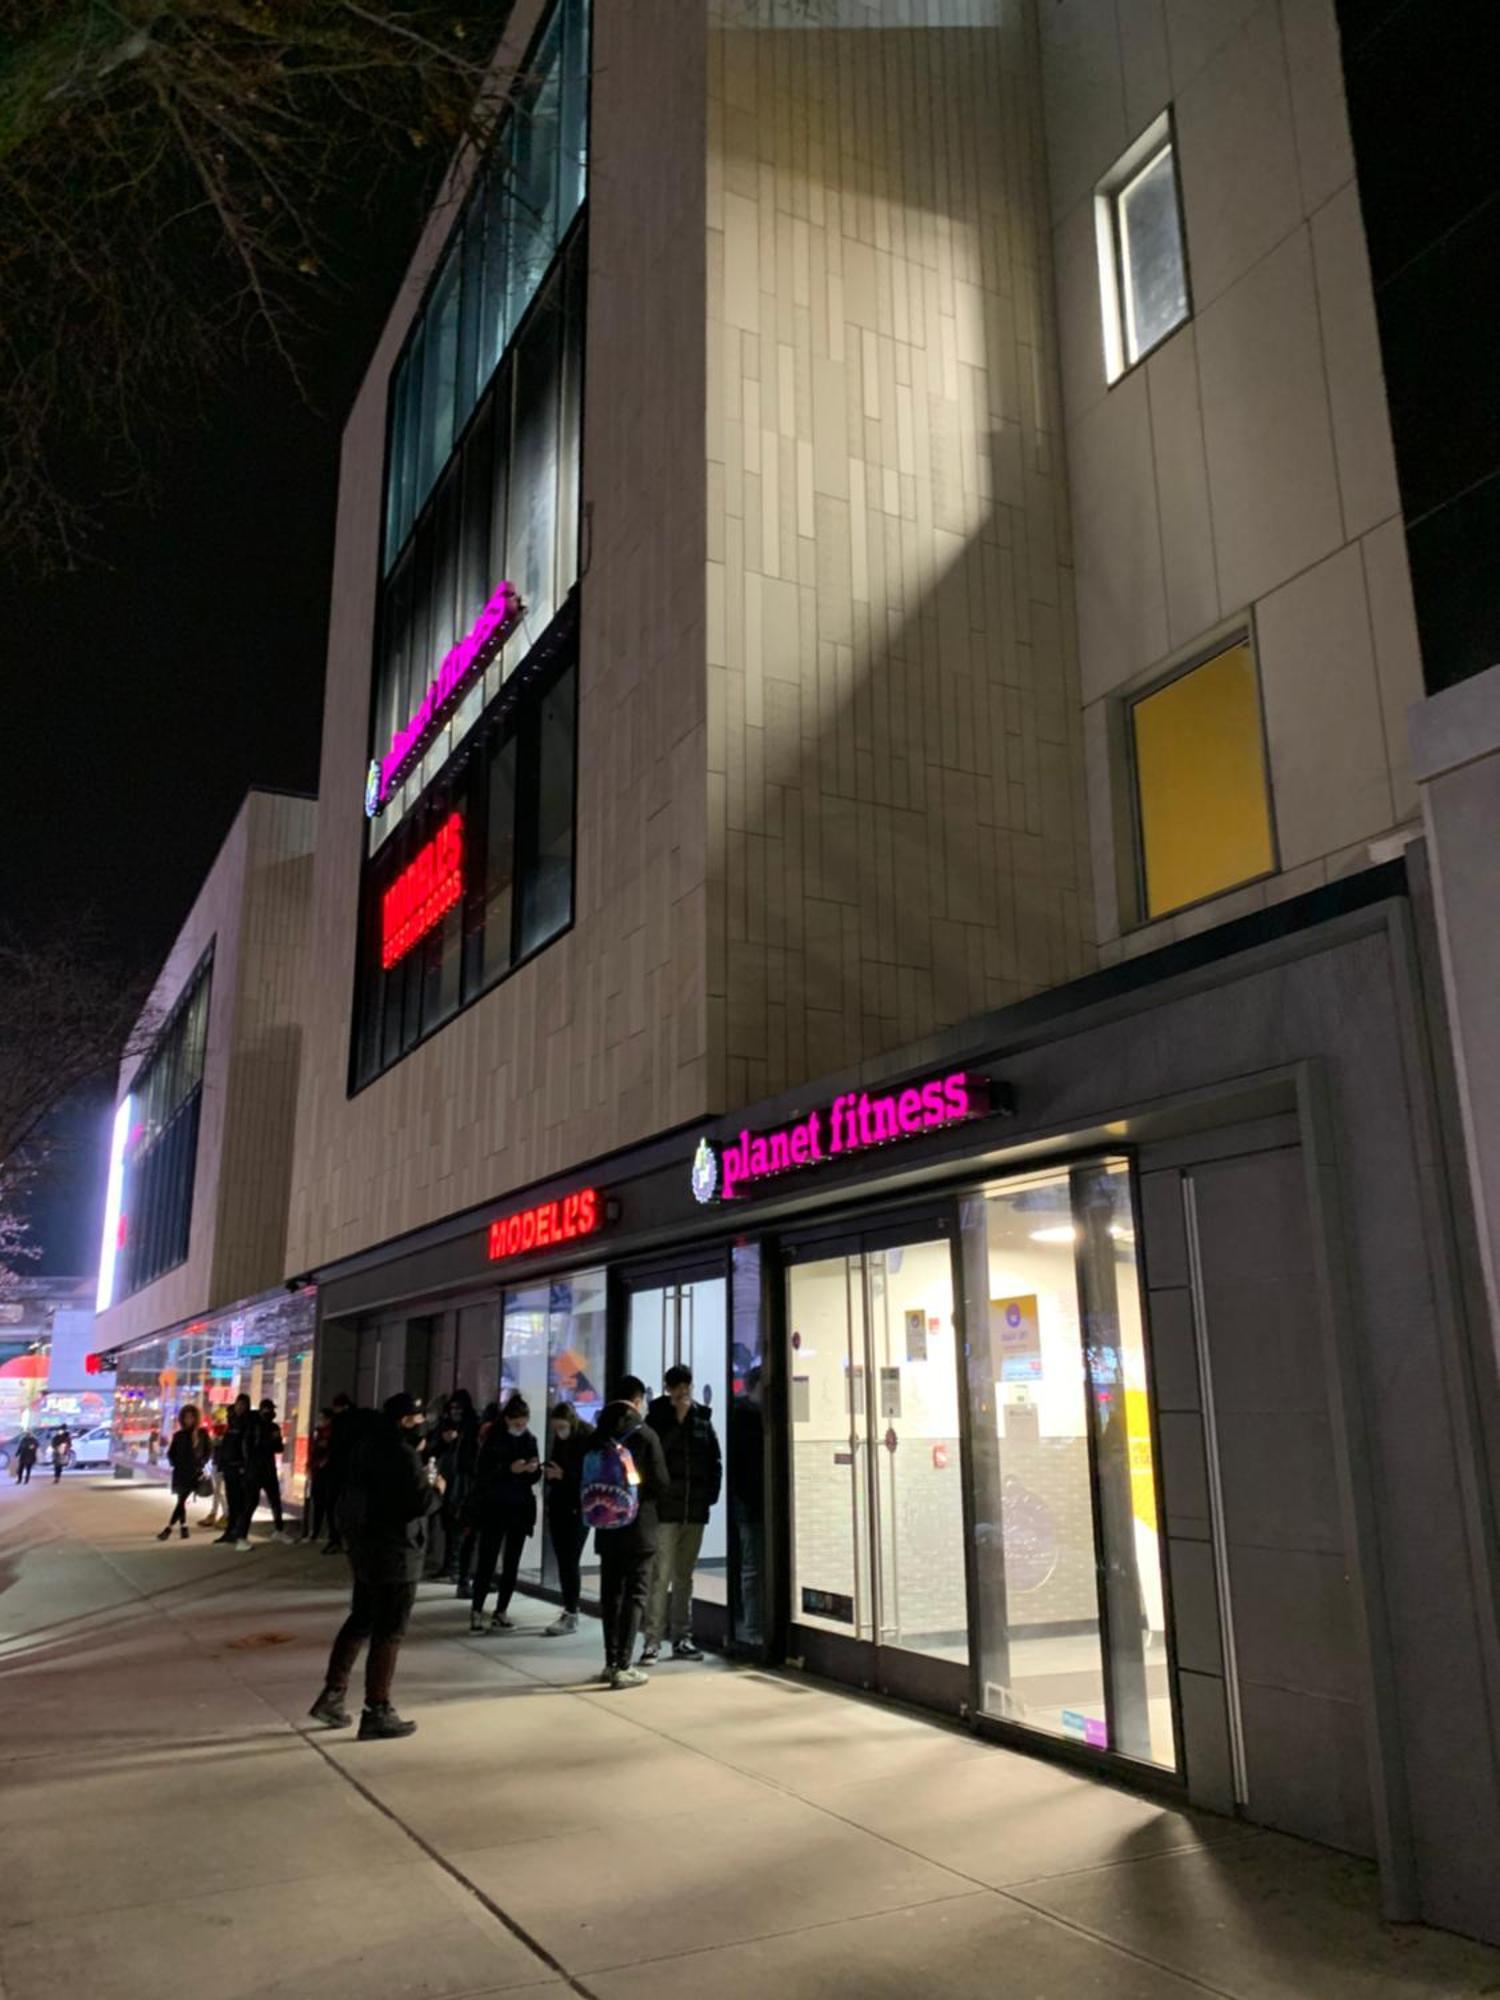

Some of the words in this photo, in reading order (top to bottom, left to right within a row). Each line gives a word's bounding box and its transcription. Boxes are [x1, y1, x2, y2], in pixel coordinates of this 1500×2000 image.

[721, 1112, 821, 1199] planet
[830, 1072, 969, 1152] fitness
[488, 1187, 597, 1260] MODELL'S
